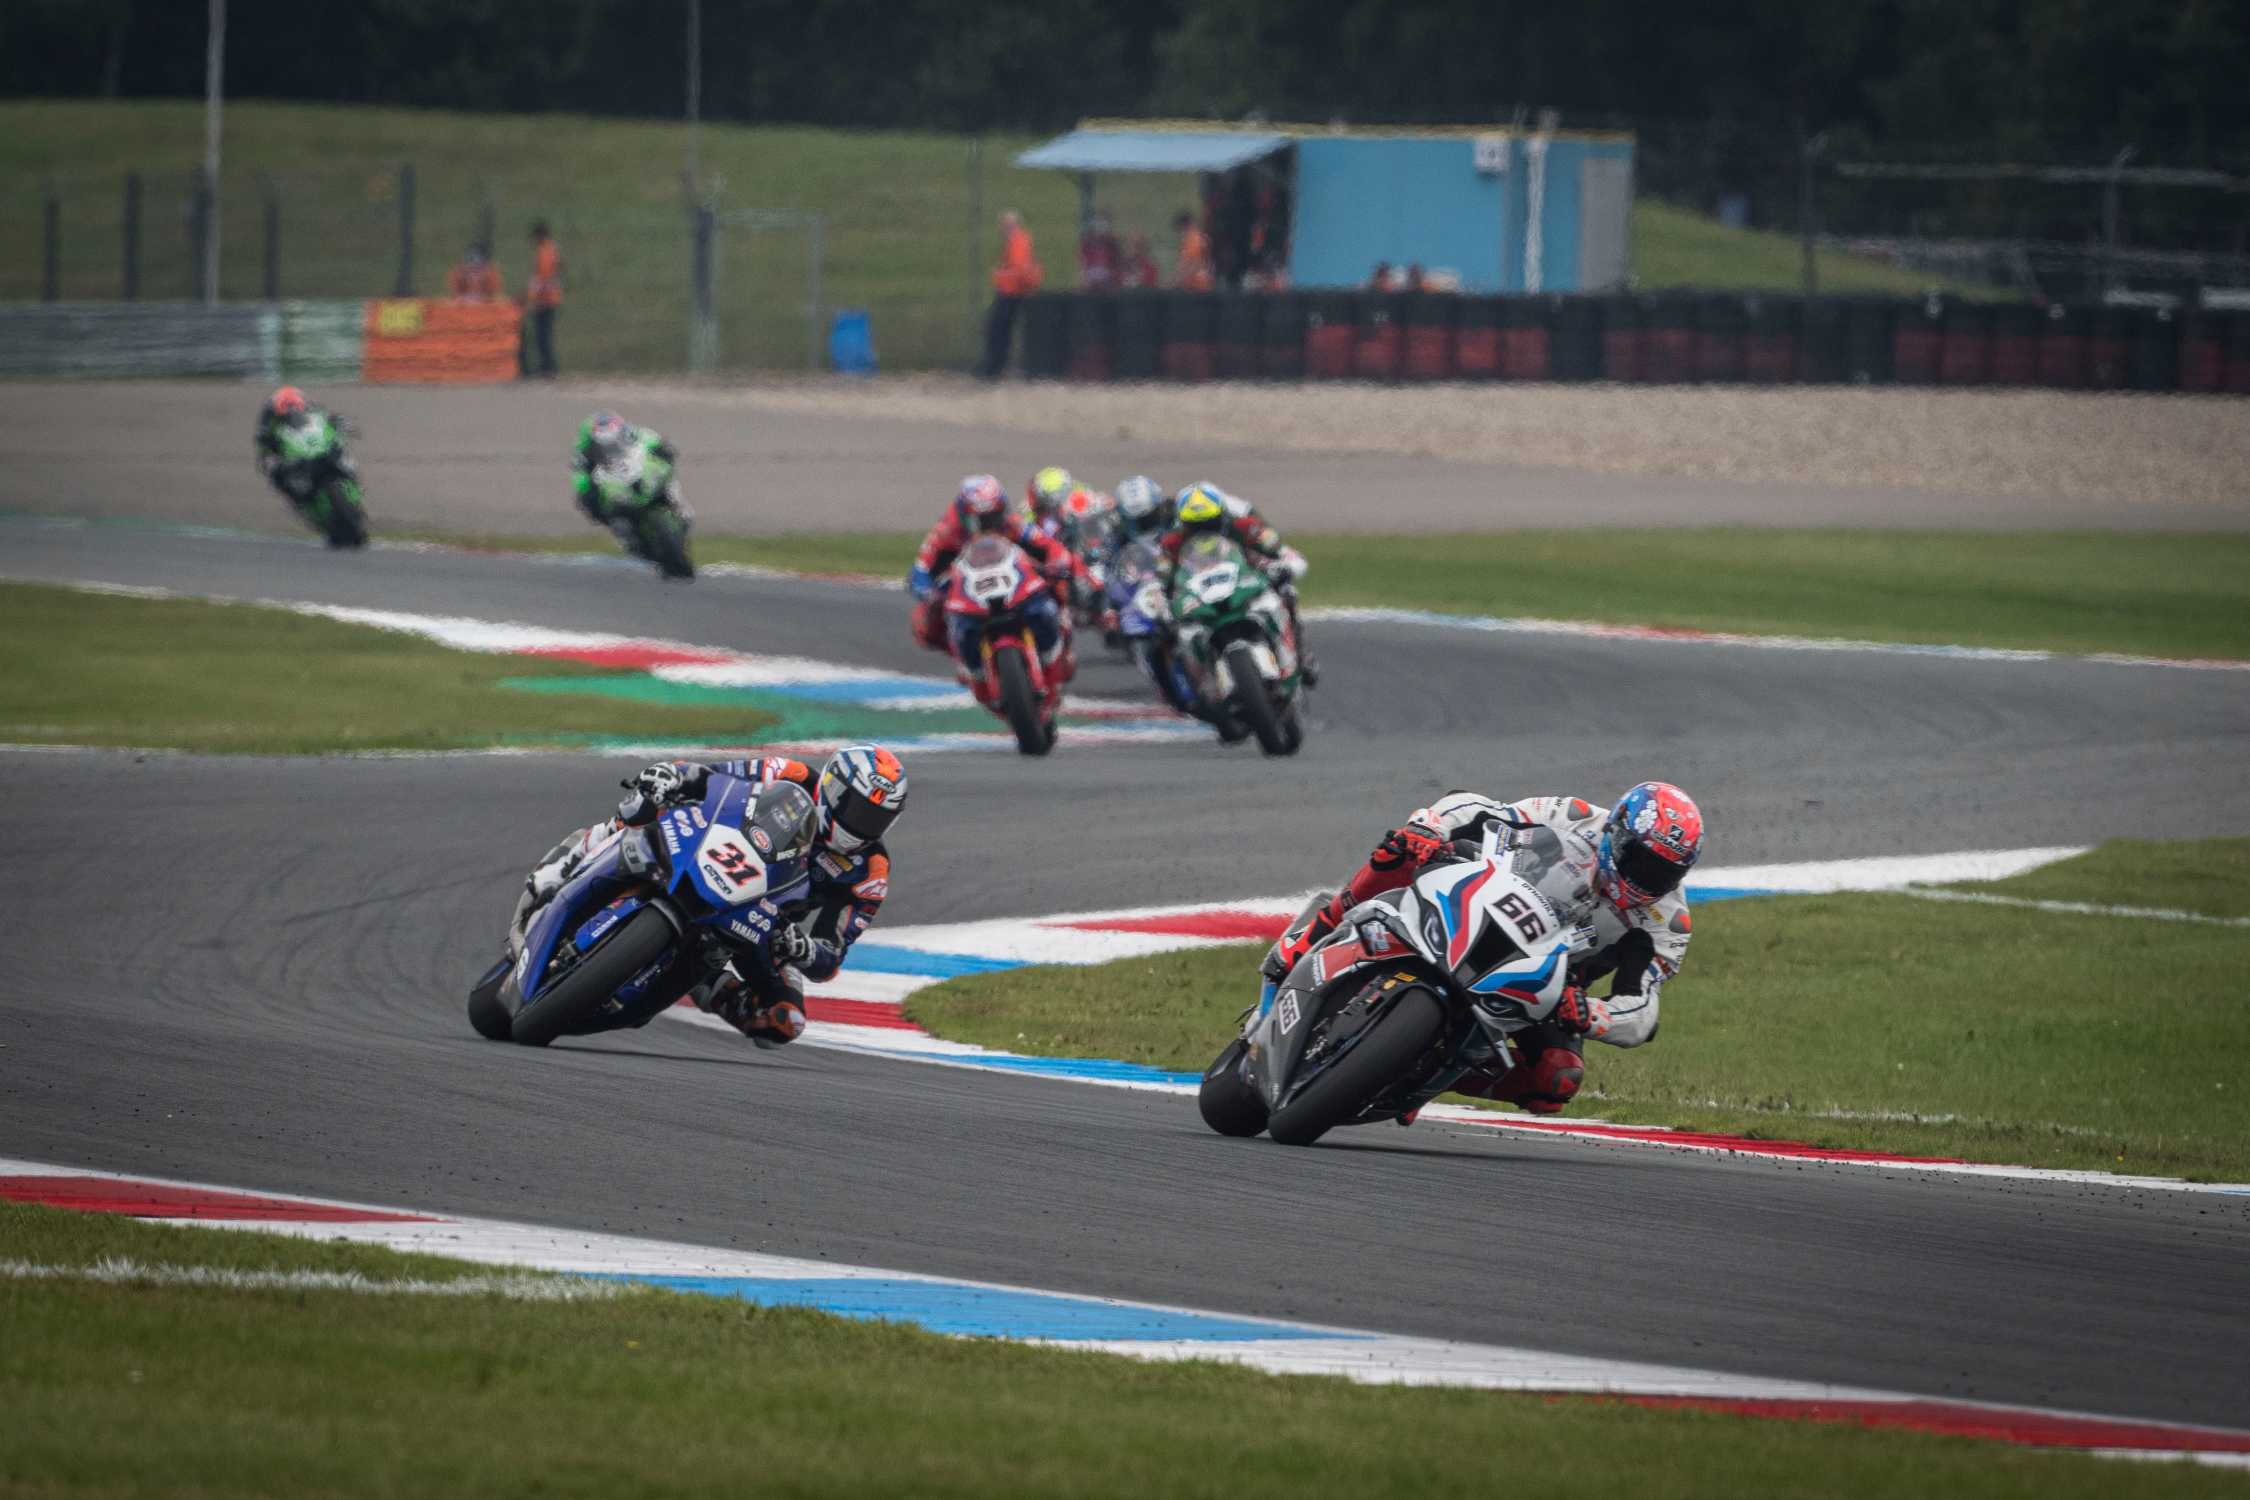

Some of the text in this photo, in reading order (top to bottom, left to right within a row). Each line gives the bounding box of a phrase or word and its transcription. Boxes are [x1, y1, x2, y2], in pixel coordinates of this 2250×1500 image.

[661, 819, 681, 855] YAMAHA
[706, 842, 762, 886] 31
[731, 919, 760, 945] YAMAHA
[1492, 892, 1547, 944] 66
[1281, 995, 1298, 1031] 66
